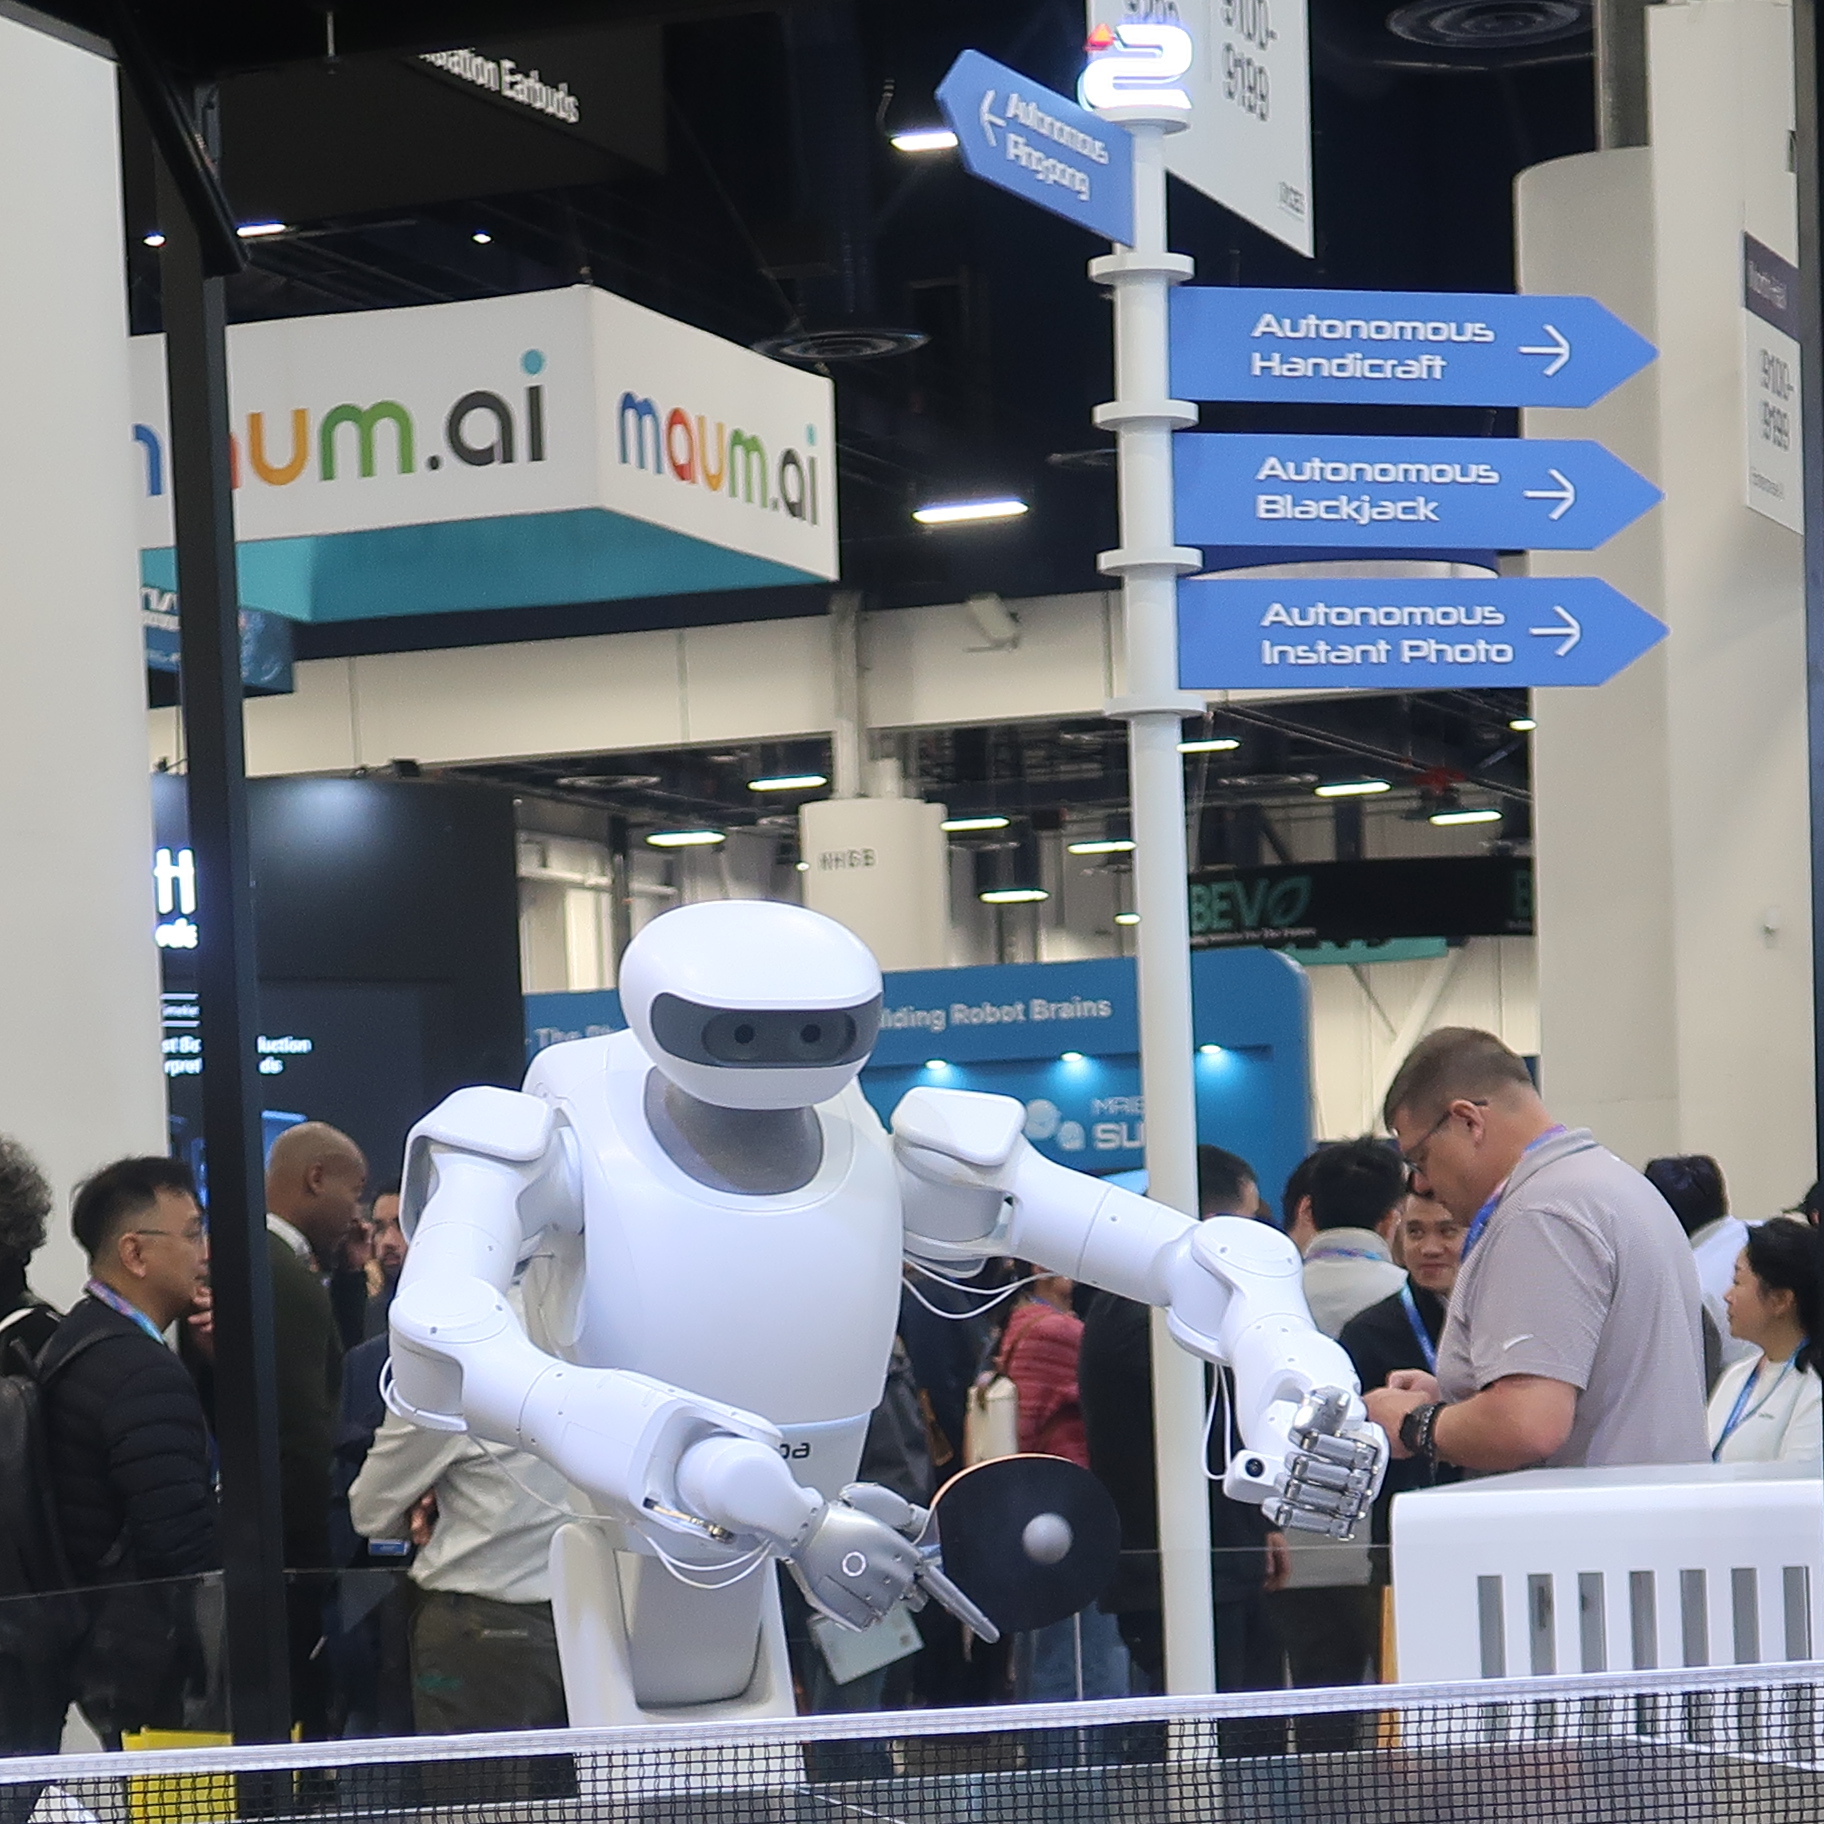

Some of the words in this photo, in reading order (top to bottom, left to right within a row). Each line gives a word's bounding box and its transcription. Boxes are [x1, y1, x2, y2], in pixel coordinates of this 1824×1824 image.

[500, 58, 580, 123] Earbuds
[1006, 93, 1110, 165] Autonomous
[1251, 313, 1495, 342] Autonomous
[1251, 352, 1447, 379] Handicraft
[133, 349, 546, 497] um.ai
[617, 390, 819, 526] maum.ai
[1256, 456, 1500, 484] Autonomous
[1256, 495, 1440, 524] Blackjack
[1260, 603, 1505, 628] Autonomous
[1261, 640, 1392, 664] Instant
[1399, 640, 1514, 664] Photo
[949, 1002, 1027, 1026] Robot
[1029, 995, 1113, 1021] Brains
